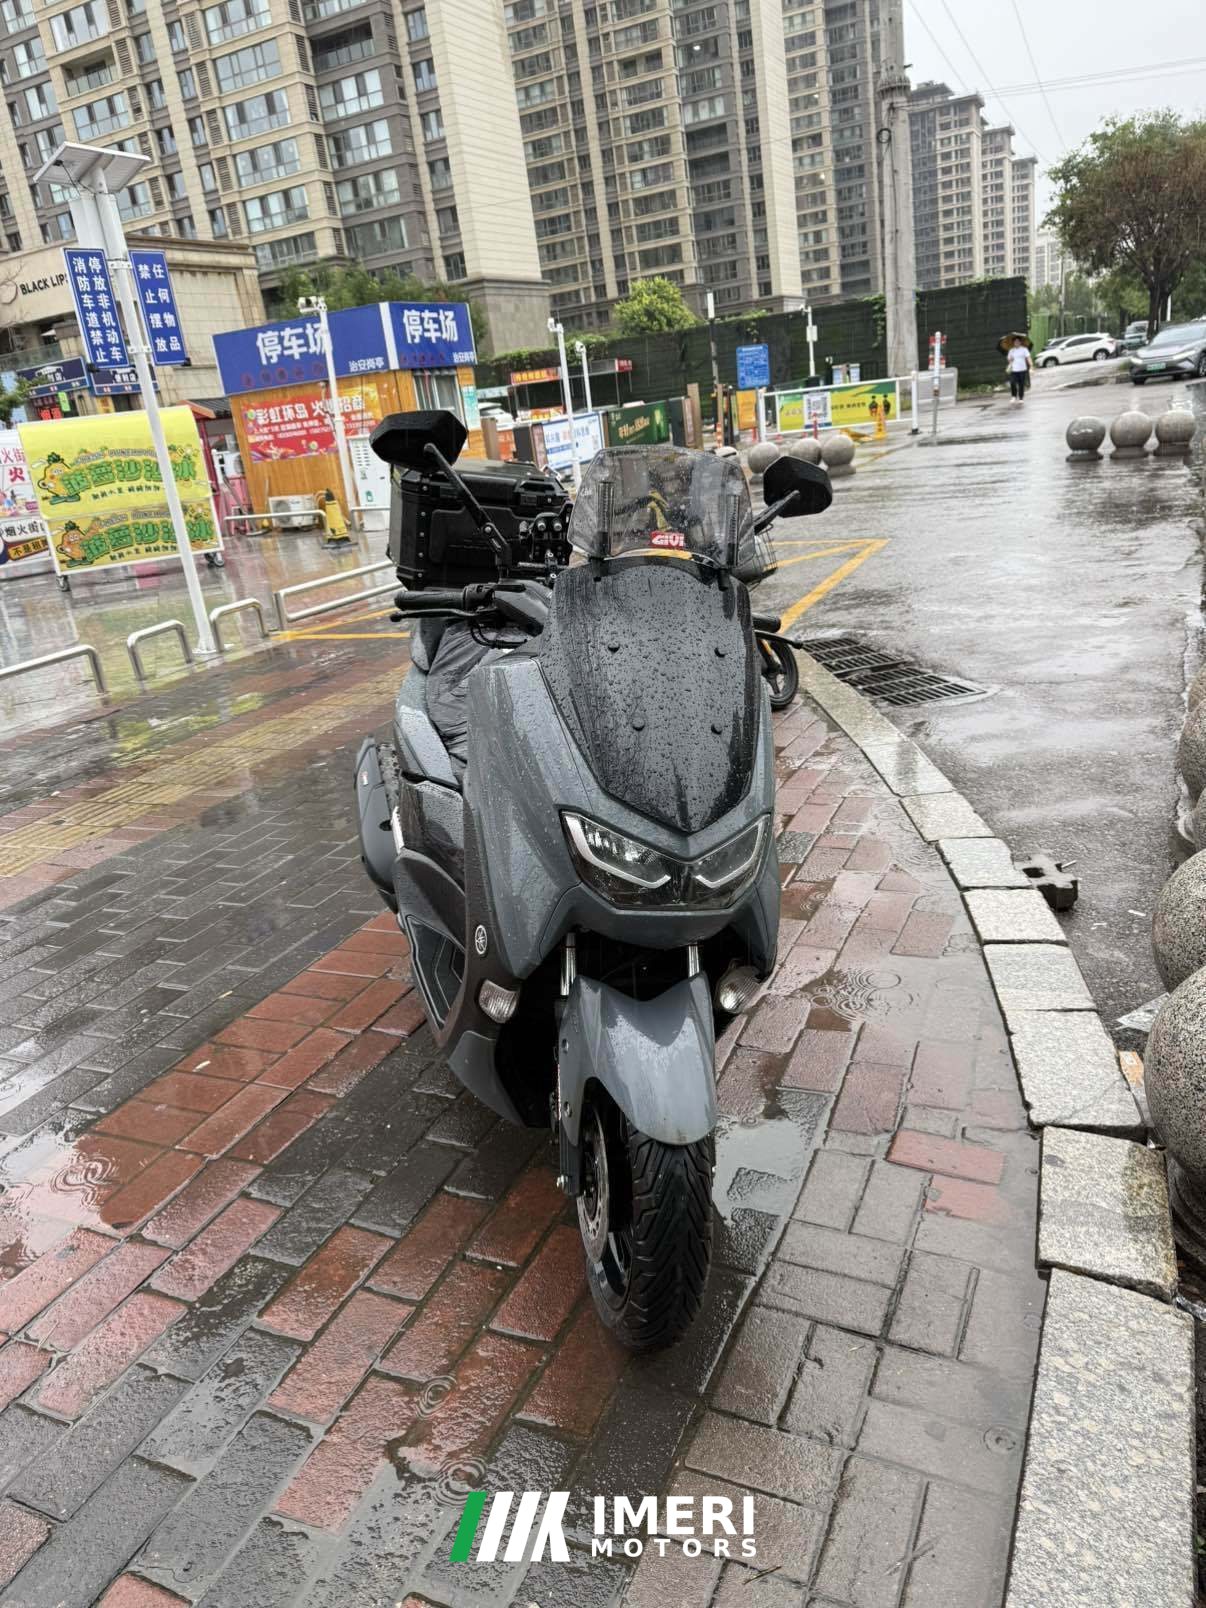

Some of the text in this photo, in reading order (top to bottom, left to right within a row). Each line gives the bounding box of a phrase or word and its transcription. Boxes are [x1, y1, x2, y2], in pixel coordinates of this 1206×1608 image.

[19, 277, 50, 295] BLACK
[152, 263, 181, 351] 任何物品
[72, 256, 109, 363] 消防车道禁止
[88, 256, 124, 362] 停放非机动车
[137, 264, 168, 352] 禁止摆放
[403, 309, 459, 344] 停车场
[256, 322, 331, 365] 停车场
[0, 447, 26, 464] 火街
[651, 533, 685, 547] GIVI
